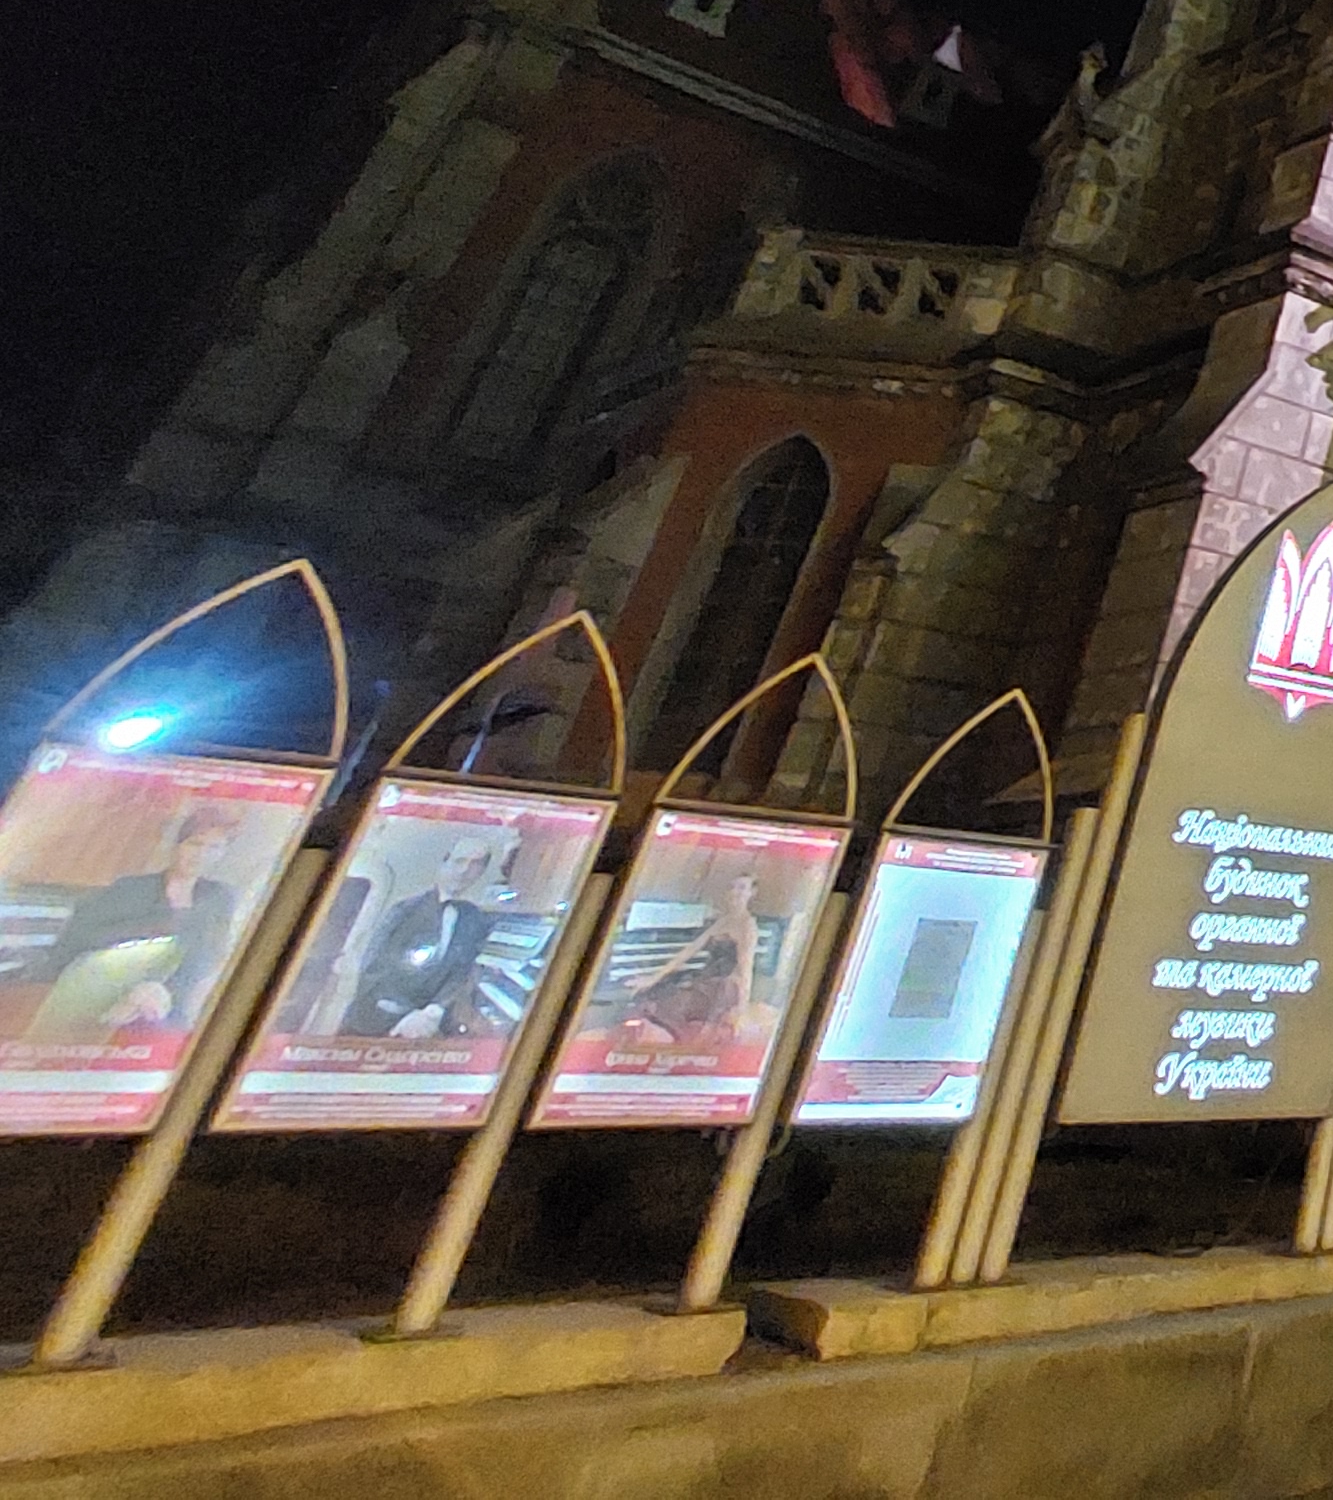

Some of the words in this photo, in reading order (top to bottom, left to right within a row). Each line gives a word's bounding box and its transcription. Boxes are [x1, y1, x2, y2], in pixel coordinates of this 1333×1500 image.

[1189, 912, 1307, 951] органної
[1152, 959, 1200, 989] та
[1198, 959, 1320, 1002] камерної
[1171, 1008, 1277, 1049] музики
[1153, 1050, 1274, 1101] України
